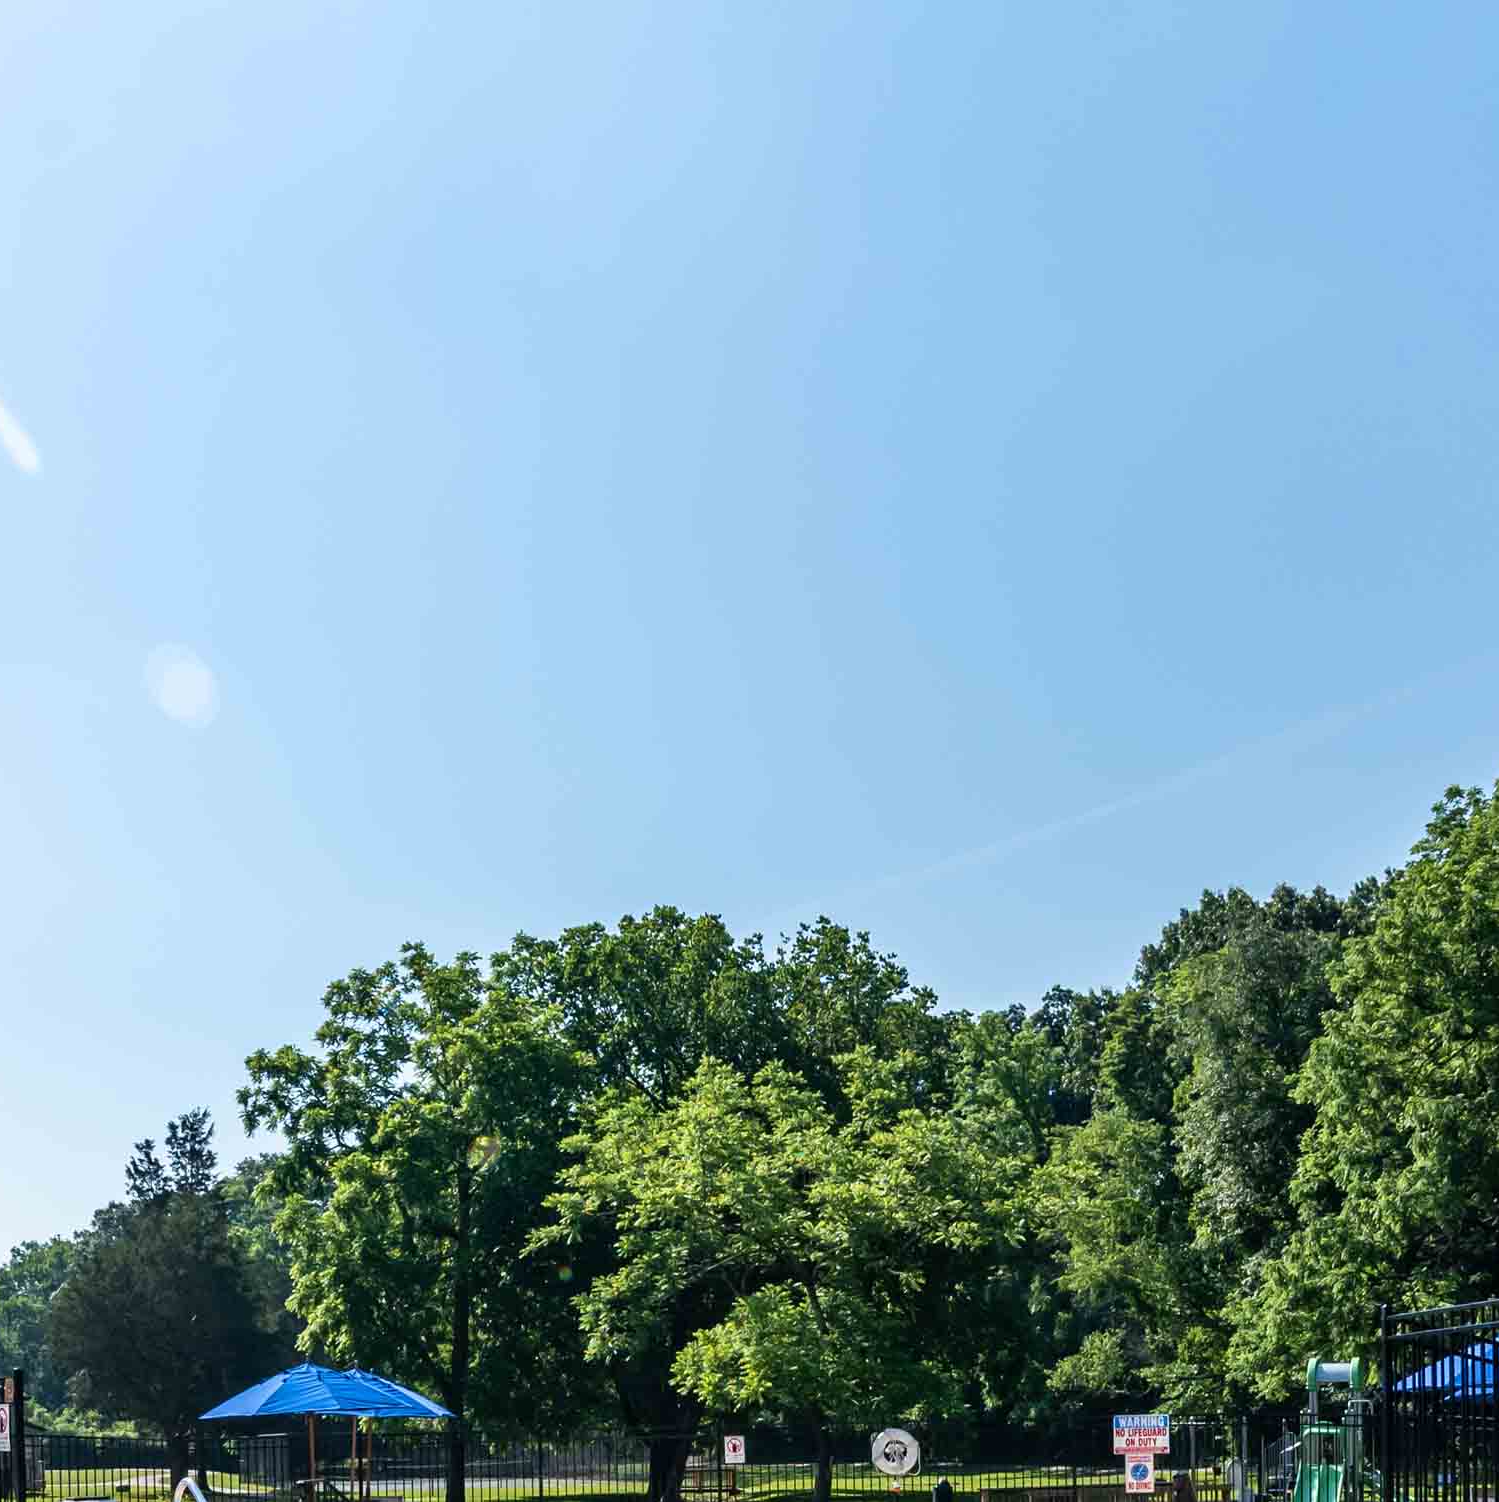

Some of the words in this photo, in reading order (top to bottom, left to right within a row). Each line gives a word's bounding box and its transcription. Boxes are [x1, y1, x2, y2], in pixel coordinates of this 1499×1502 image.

[1118, 1415, 1164, 1427] WARNING
[1115, 1428, 1125, 1437] NO
[1128, 1428, 1167, 1437] LIFEGUARD
[1139, 1438, 1157, 1446] DUTY
